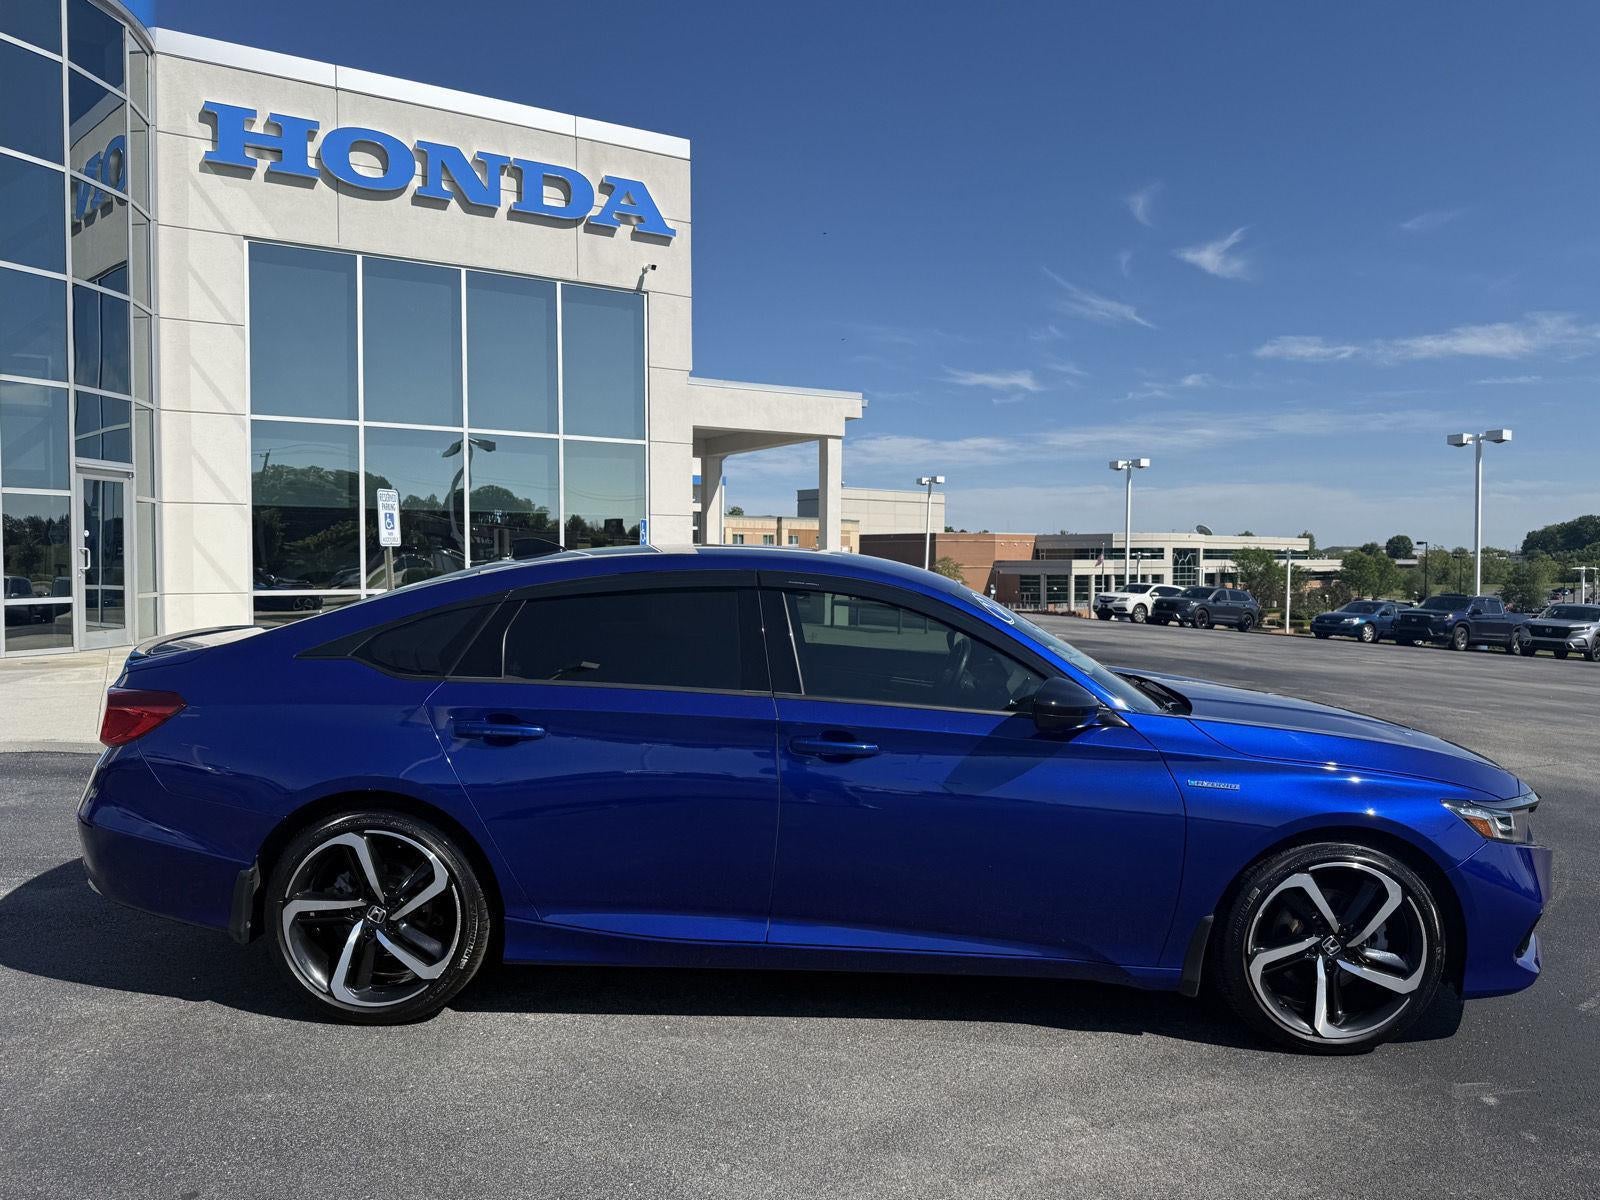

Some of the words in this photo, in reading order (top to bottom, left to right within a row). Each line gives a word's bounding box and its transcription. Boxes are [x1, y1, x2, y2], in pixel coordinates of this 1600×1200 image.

[203, 100, 677, 239] HONDA
[380, 492, 397, 502] RESERVED
[381, 503, 396, 511] PARKING
